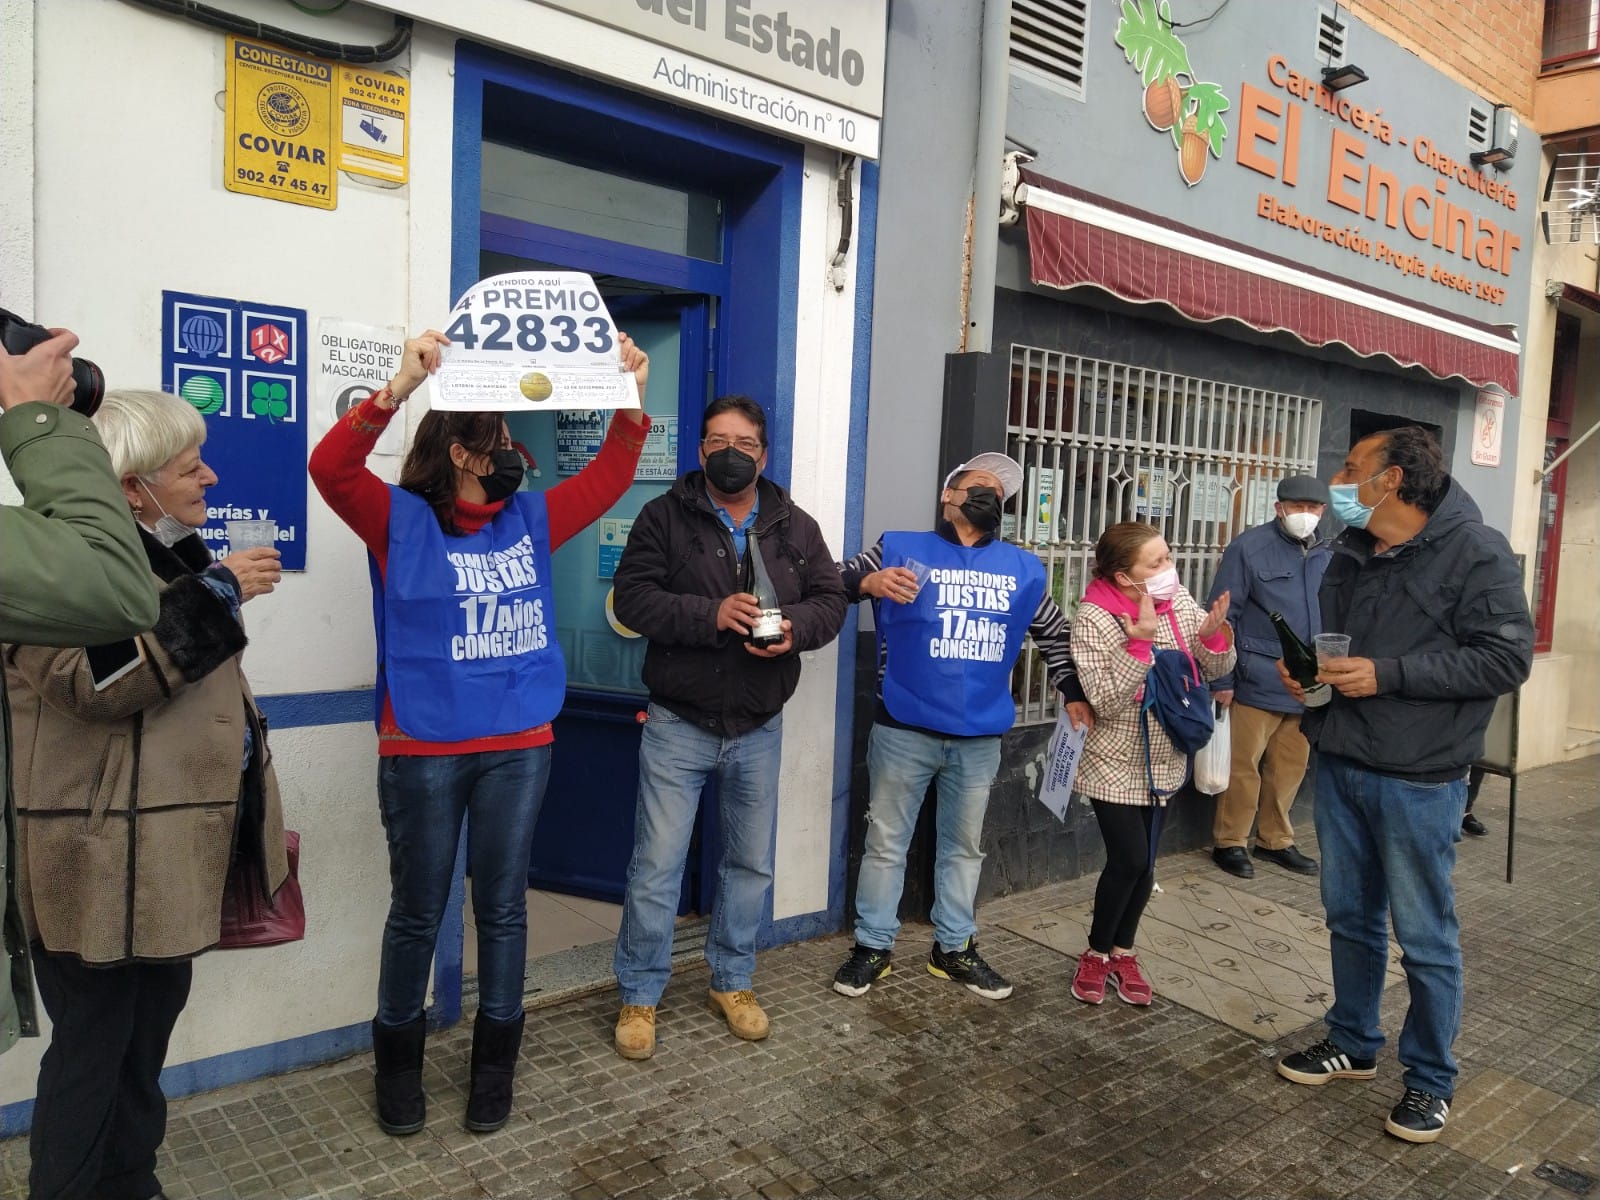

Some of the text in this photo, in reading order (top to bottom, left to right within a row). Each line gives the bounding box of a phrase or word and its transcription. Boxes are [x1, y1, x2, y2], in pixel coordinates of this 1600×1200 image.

[725, 0, 865, 87] Estado
[239, 46, 328, 79] CONECTADO
[349, 87, 401, 106] 902 47 45 47
[355, 75, 405, 96] COVIAR
[653, 57, 808, 128] Administración
[838, 118, 856, 142] 10
[1267, 54, 1393, 146] Carnicería
[1413, 135, 1518, 211] Charcutería
[239, 133, 326, 165] COVIAR
[237, 168, 328, 195] 902 47 45 47
[1236, 82, 1520, 277] El Encinar
[1257, 192, 1508, 306] Elaboración Propia desde 1997
[492, 277, 561, 287] VENDIDO AQUÍ
[483, 289, 600, 312] PREMIO
[321, 334, 402, 356] OBLIGATORIO
[444, 313, 613, 353] 42833
[322, 363, 393, 382] MASCARILL
[329, 350, 394, 369] EL USO DE
[455, 555, 537, 593] JUSTAS
[930, 568, 1017, 591] COMISIONES
[937, 583, 1010, 612] JUSTAS
[459, 594, 543, 634] 17 AÑOS
[938, 610, 1008, 644] 17 AÑOS
[451, 624, 548, 661] CONGELADAS
[929, 638, 1006, 663] CONGELADAS
